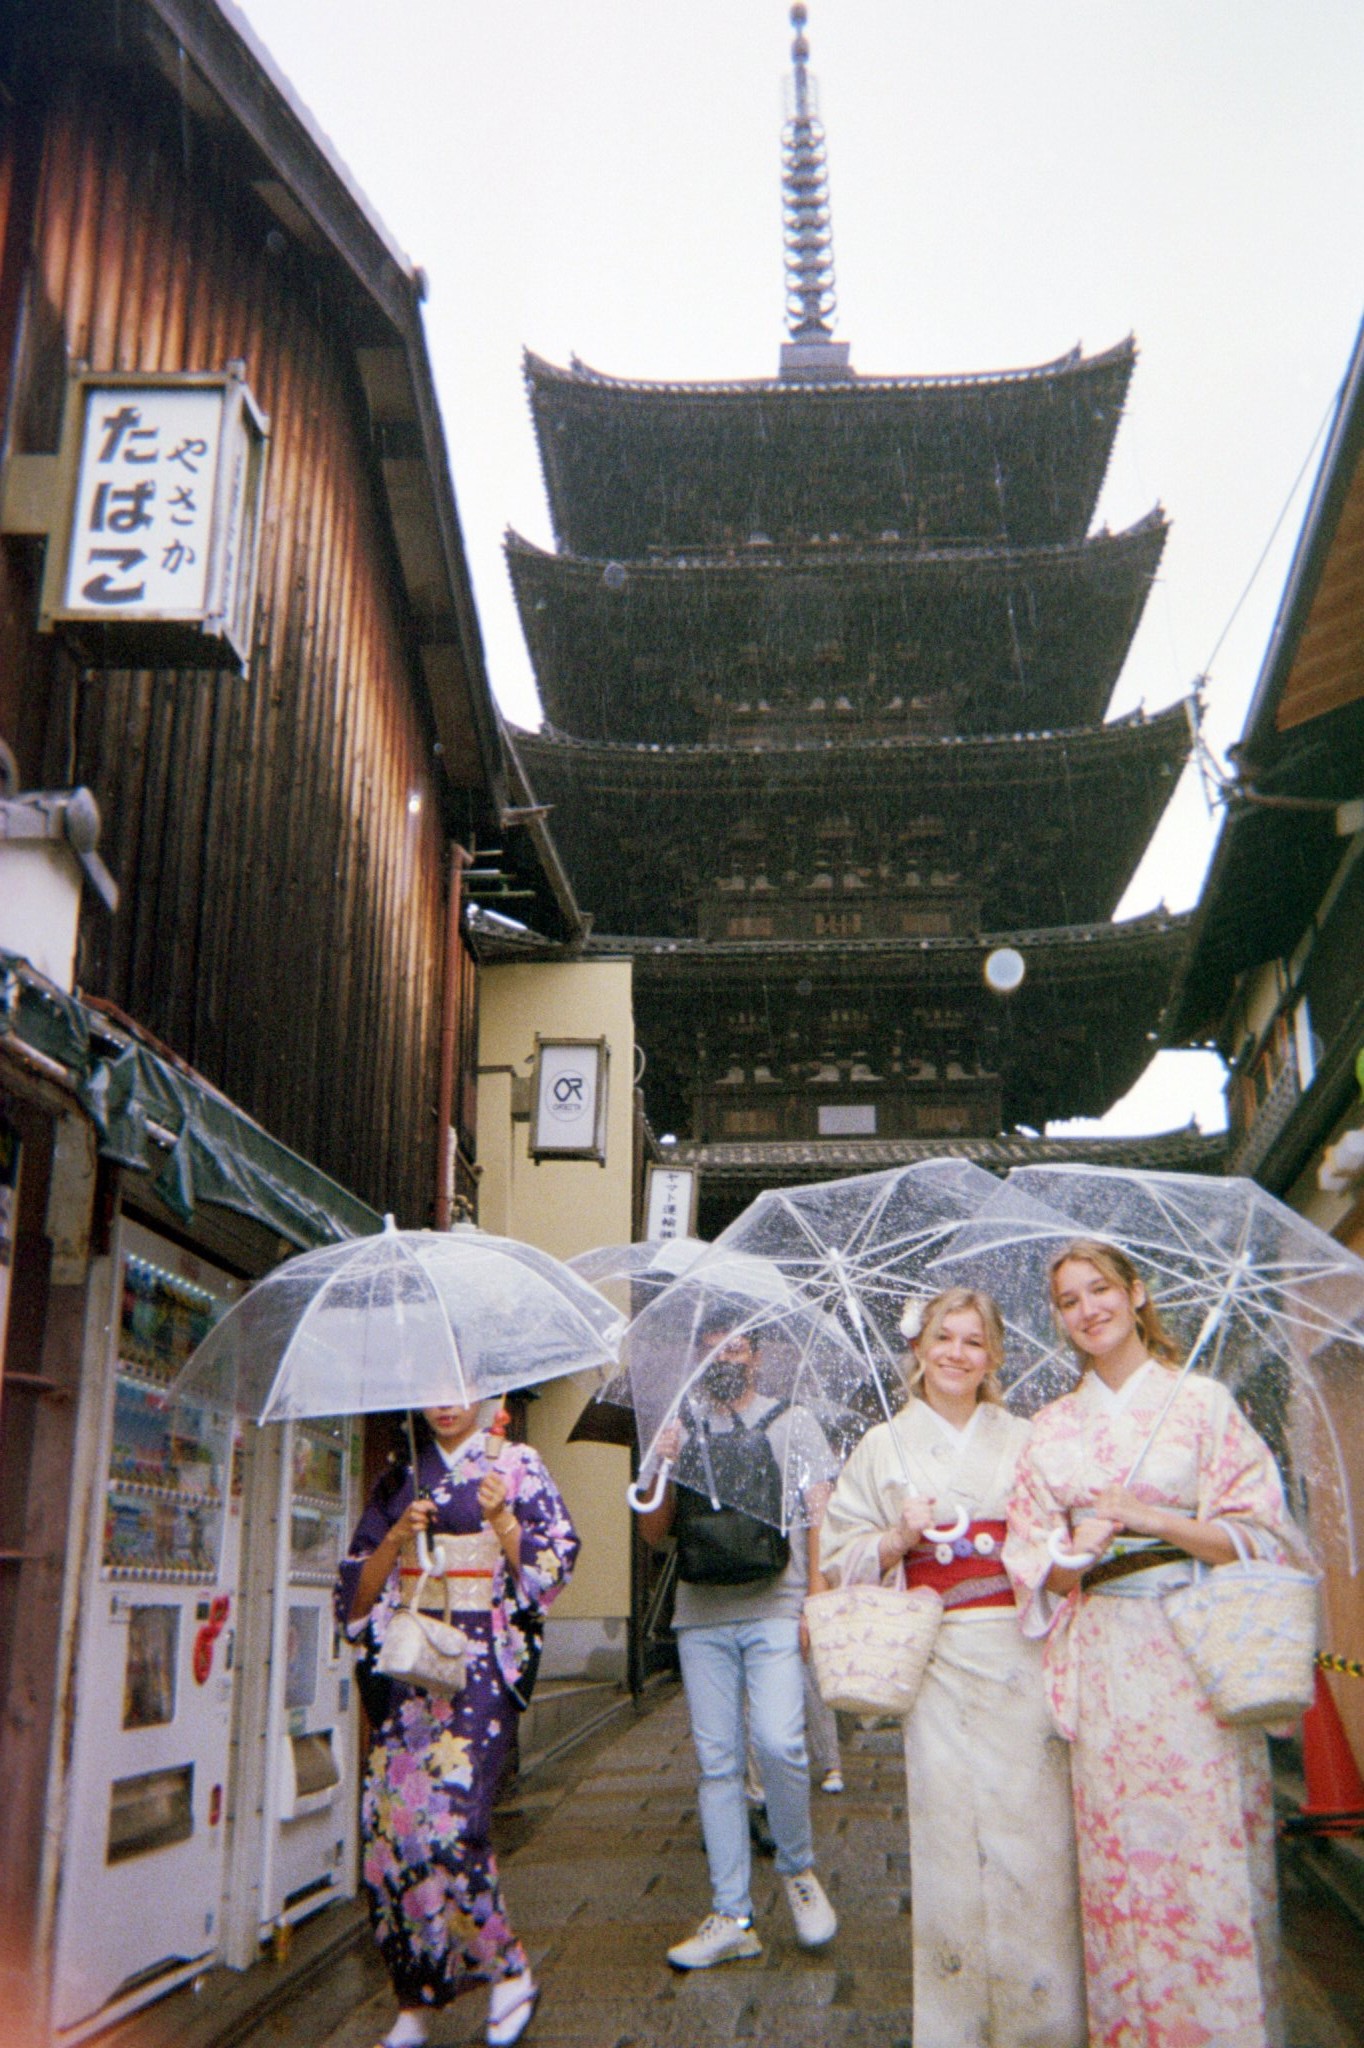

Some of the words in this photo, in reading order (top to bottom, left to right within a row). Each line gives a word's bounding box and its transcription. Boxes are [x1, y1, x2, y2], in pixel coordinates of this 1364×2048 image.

[81, 406, 160, 605] たばこ
[161, 437, 209, 574] やさか
